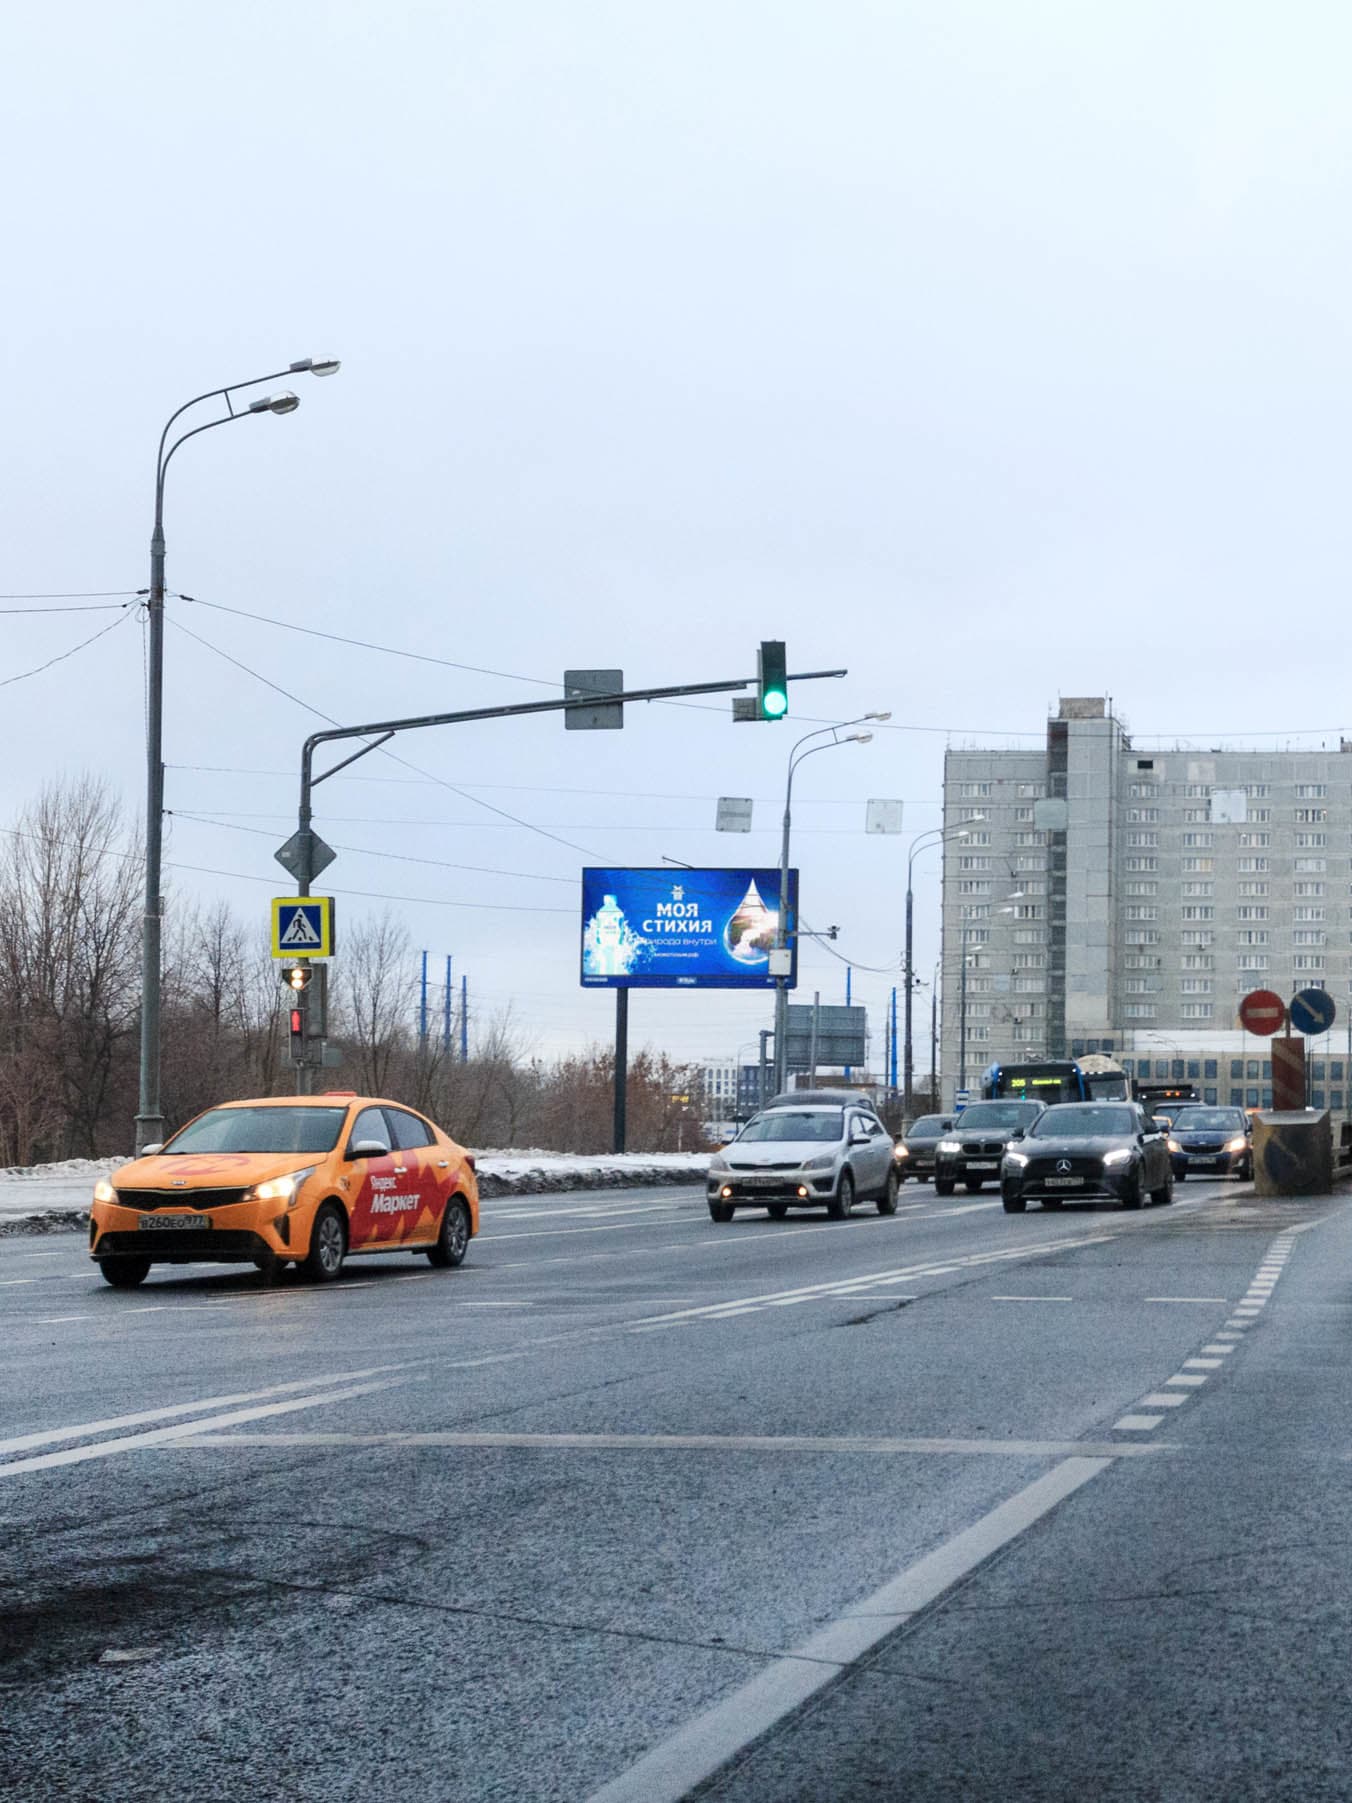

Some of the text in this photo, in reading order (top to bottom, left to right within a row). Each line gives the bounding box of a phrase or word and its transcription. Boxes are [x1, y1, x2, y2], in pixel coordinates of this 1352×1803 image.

[656, 903, 698, 917] МОЯ
[642, 919, 712, 933] СТИХИЯ
[370, 1194, 420, 1215] Маркет
